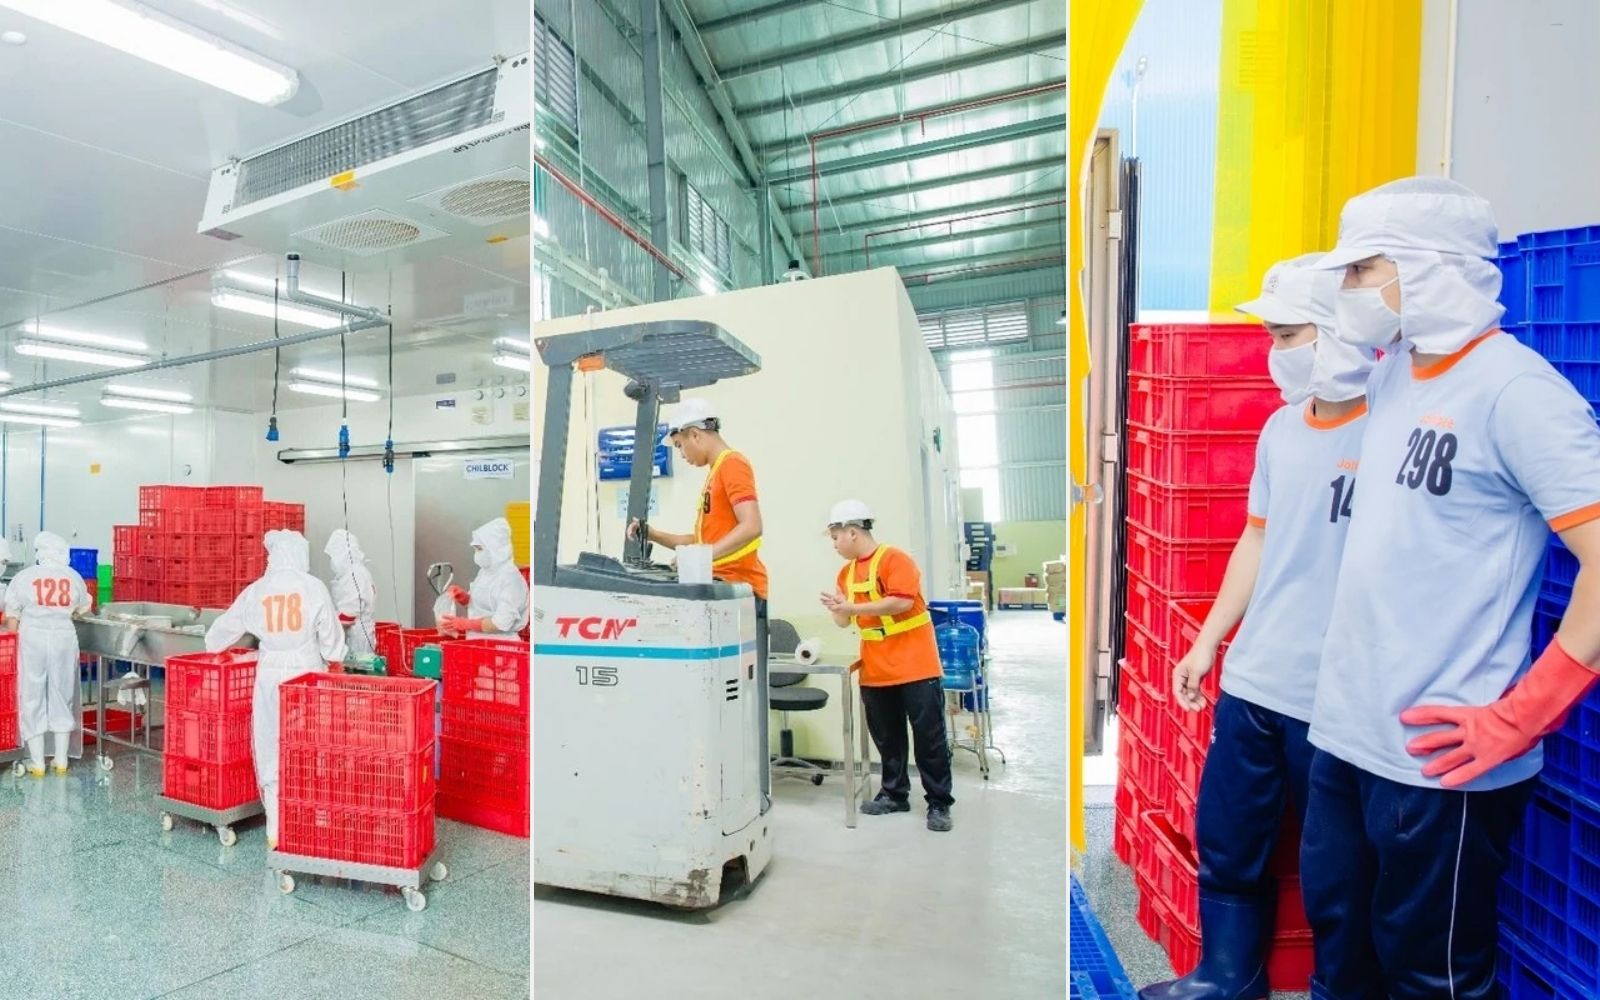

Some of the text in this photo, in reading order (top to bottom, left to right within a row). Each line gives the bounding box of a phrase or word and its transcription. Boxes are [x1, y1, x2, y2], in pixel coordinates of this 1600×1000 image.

[466, 464, 510, 472] CHILBLOCK
[1395, 427, 1458, 497] 298
[33, 578, 71, 606] 128
[262, 593, 302, 632] 178
[555, 617, 637, 640] TCM
[576, 665, 619, 686] 15
